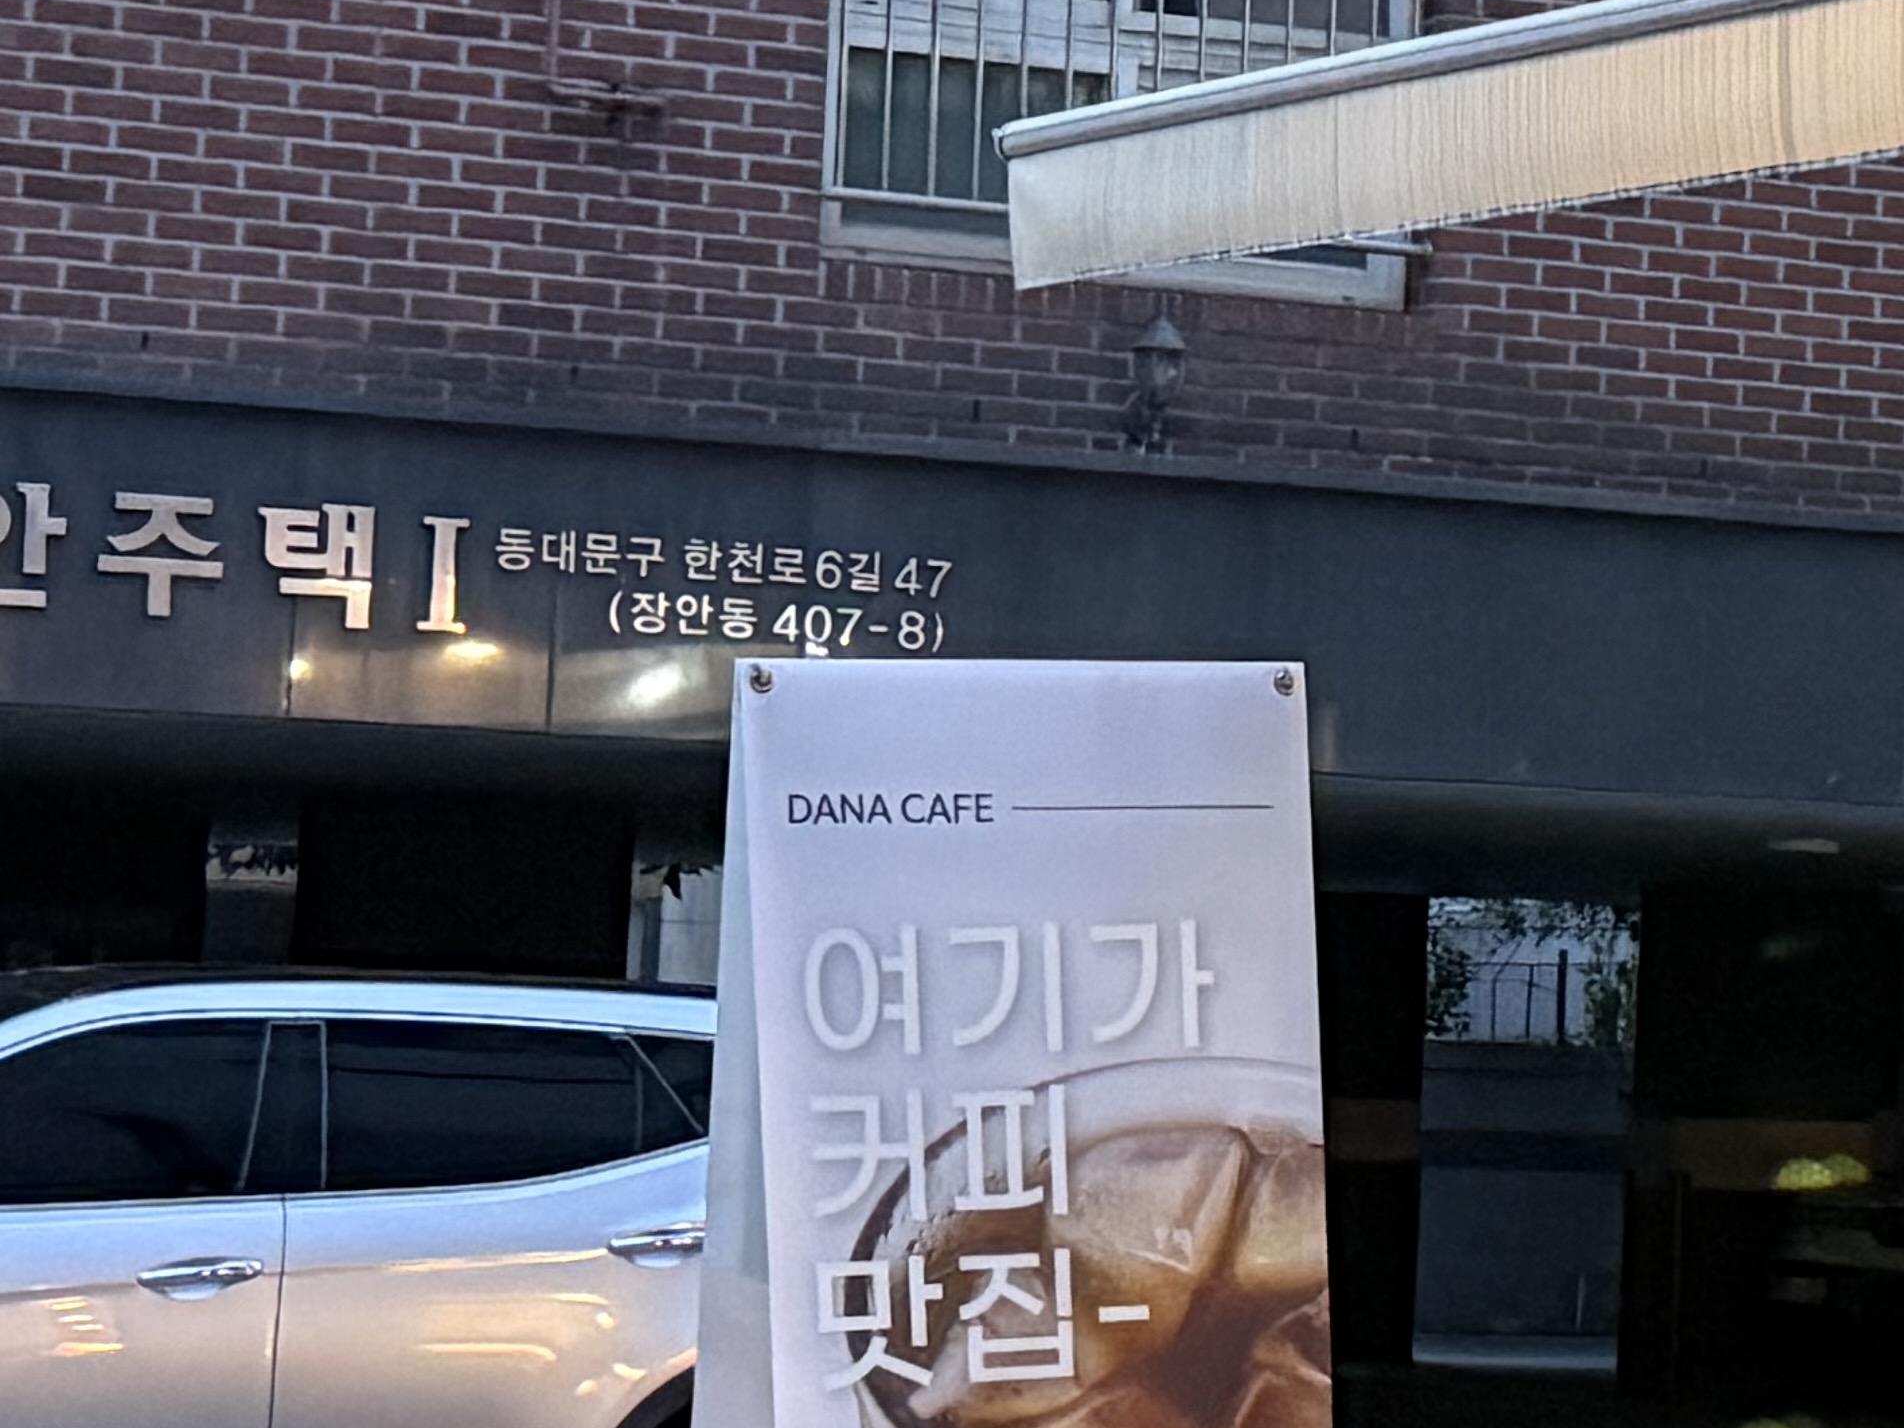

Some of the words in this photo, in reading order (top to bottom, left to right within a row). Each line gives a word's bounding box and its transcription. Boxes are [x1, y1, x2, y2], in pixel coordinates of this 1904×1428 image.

[494, 529, 667, 578] 동대문구
[684, 538, 883, 593] 한천로6길
[894, 557, 953, 598] 47
[608, 589, 759, 641] (장안동
[771, 603, 946, 652] 407-8)
[787, 792, 893, 826] DANA
[901, 791, 996, 825] CAFE
[804, 918, 1215, 1055] 여기가
[810, 1084, 1071, 1223] 커피
